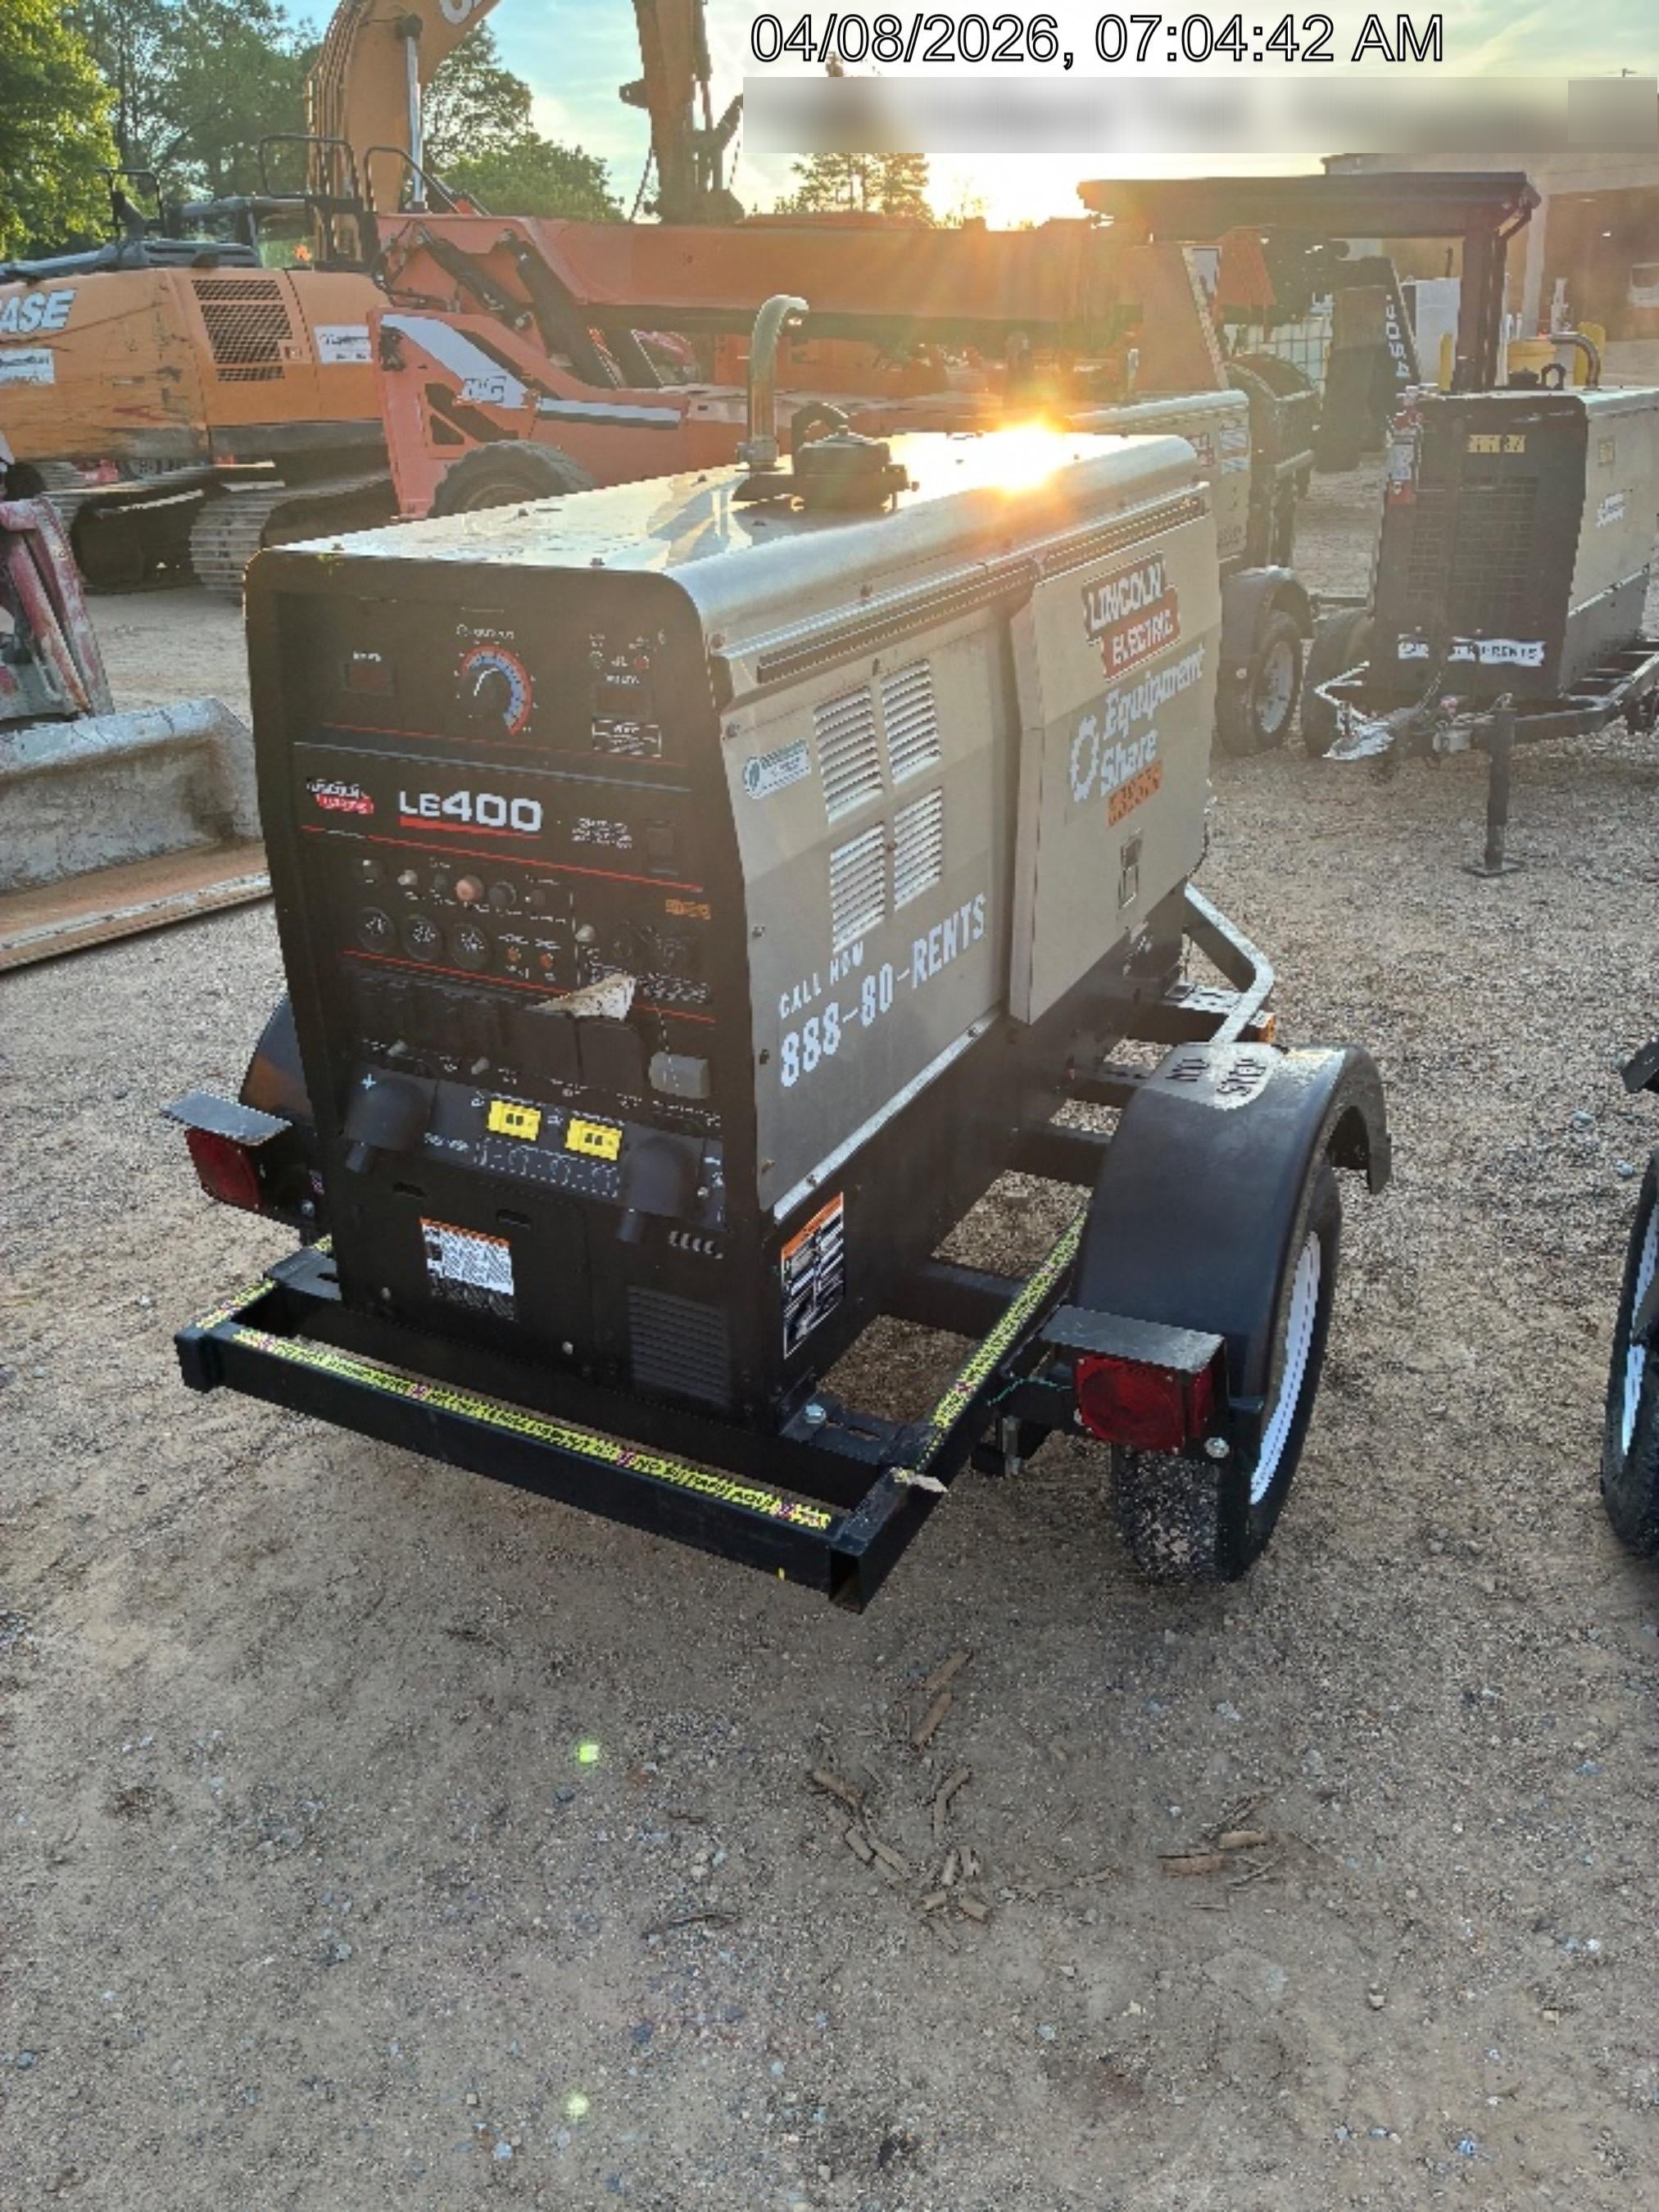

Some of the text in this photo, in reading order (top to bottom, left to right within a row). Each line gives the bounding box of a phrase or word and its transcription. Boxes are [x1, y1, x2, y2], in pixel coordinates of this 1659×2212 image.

[0, 289, 77, 333] ASE
[1088, 561, 1164, 631] LINCOLN
[1112, 609, 1173, 667] ELECTRIC
[1103, 643, 1206, 740] Equipment
[1100, 728, 1159, 797] Share
[399, 790, 543, 832] LE400
[779, 941, 864, 1020] CALL NOW
[780, 891, 987, 1088] 888-80-RENTS
